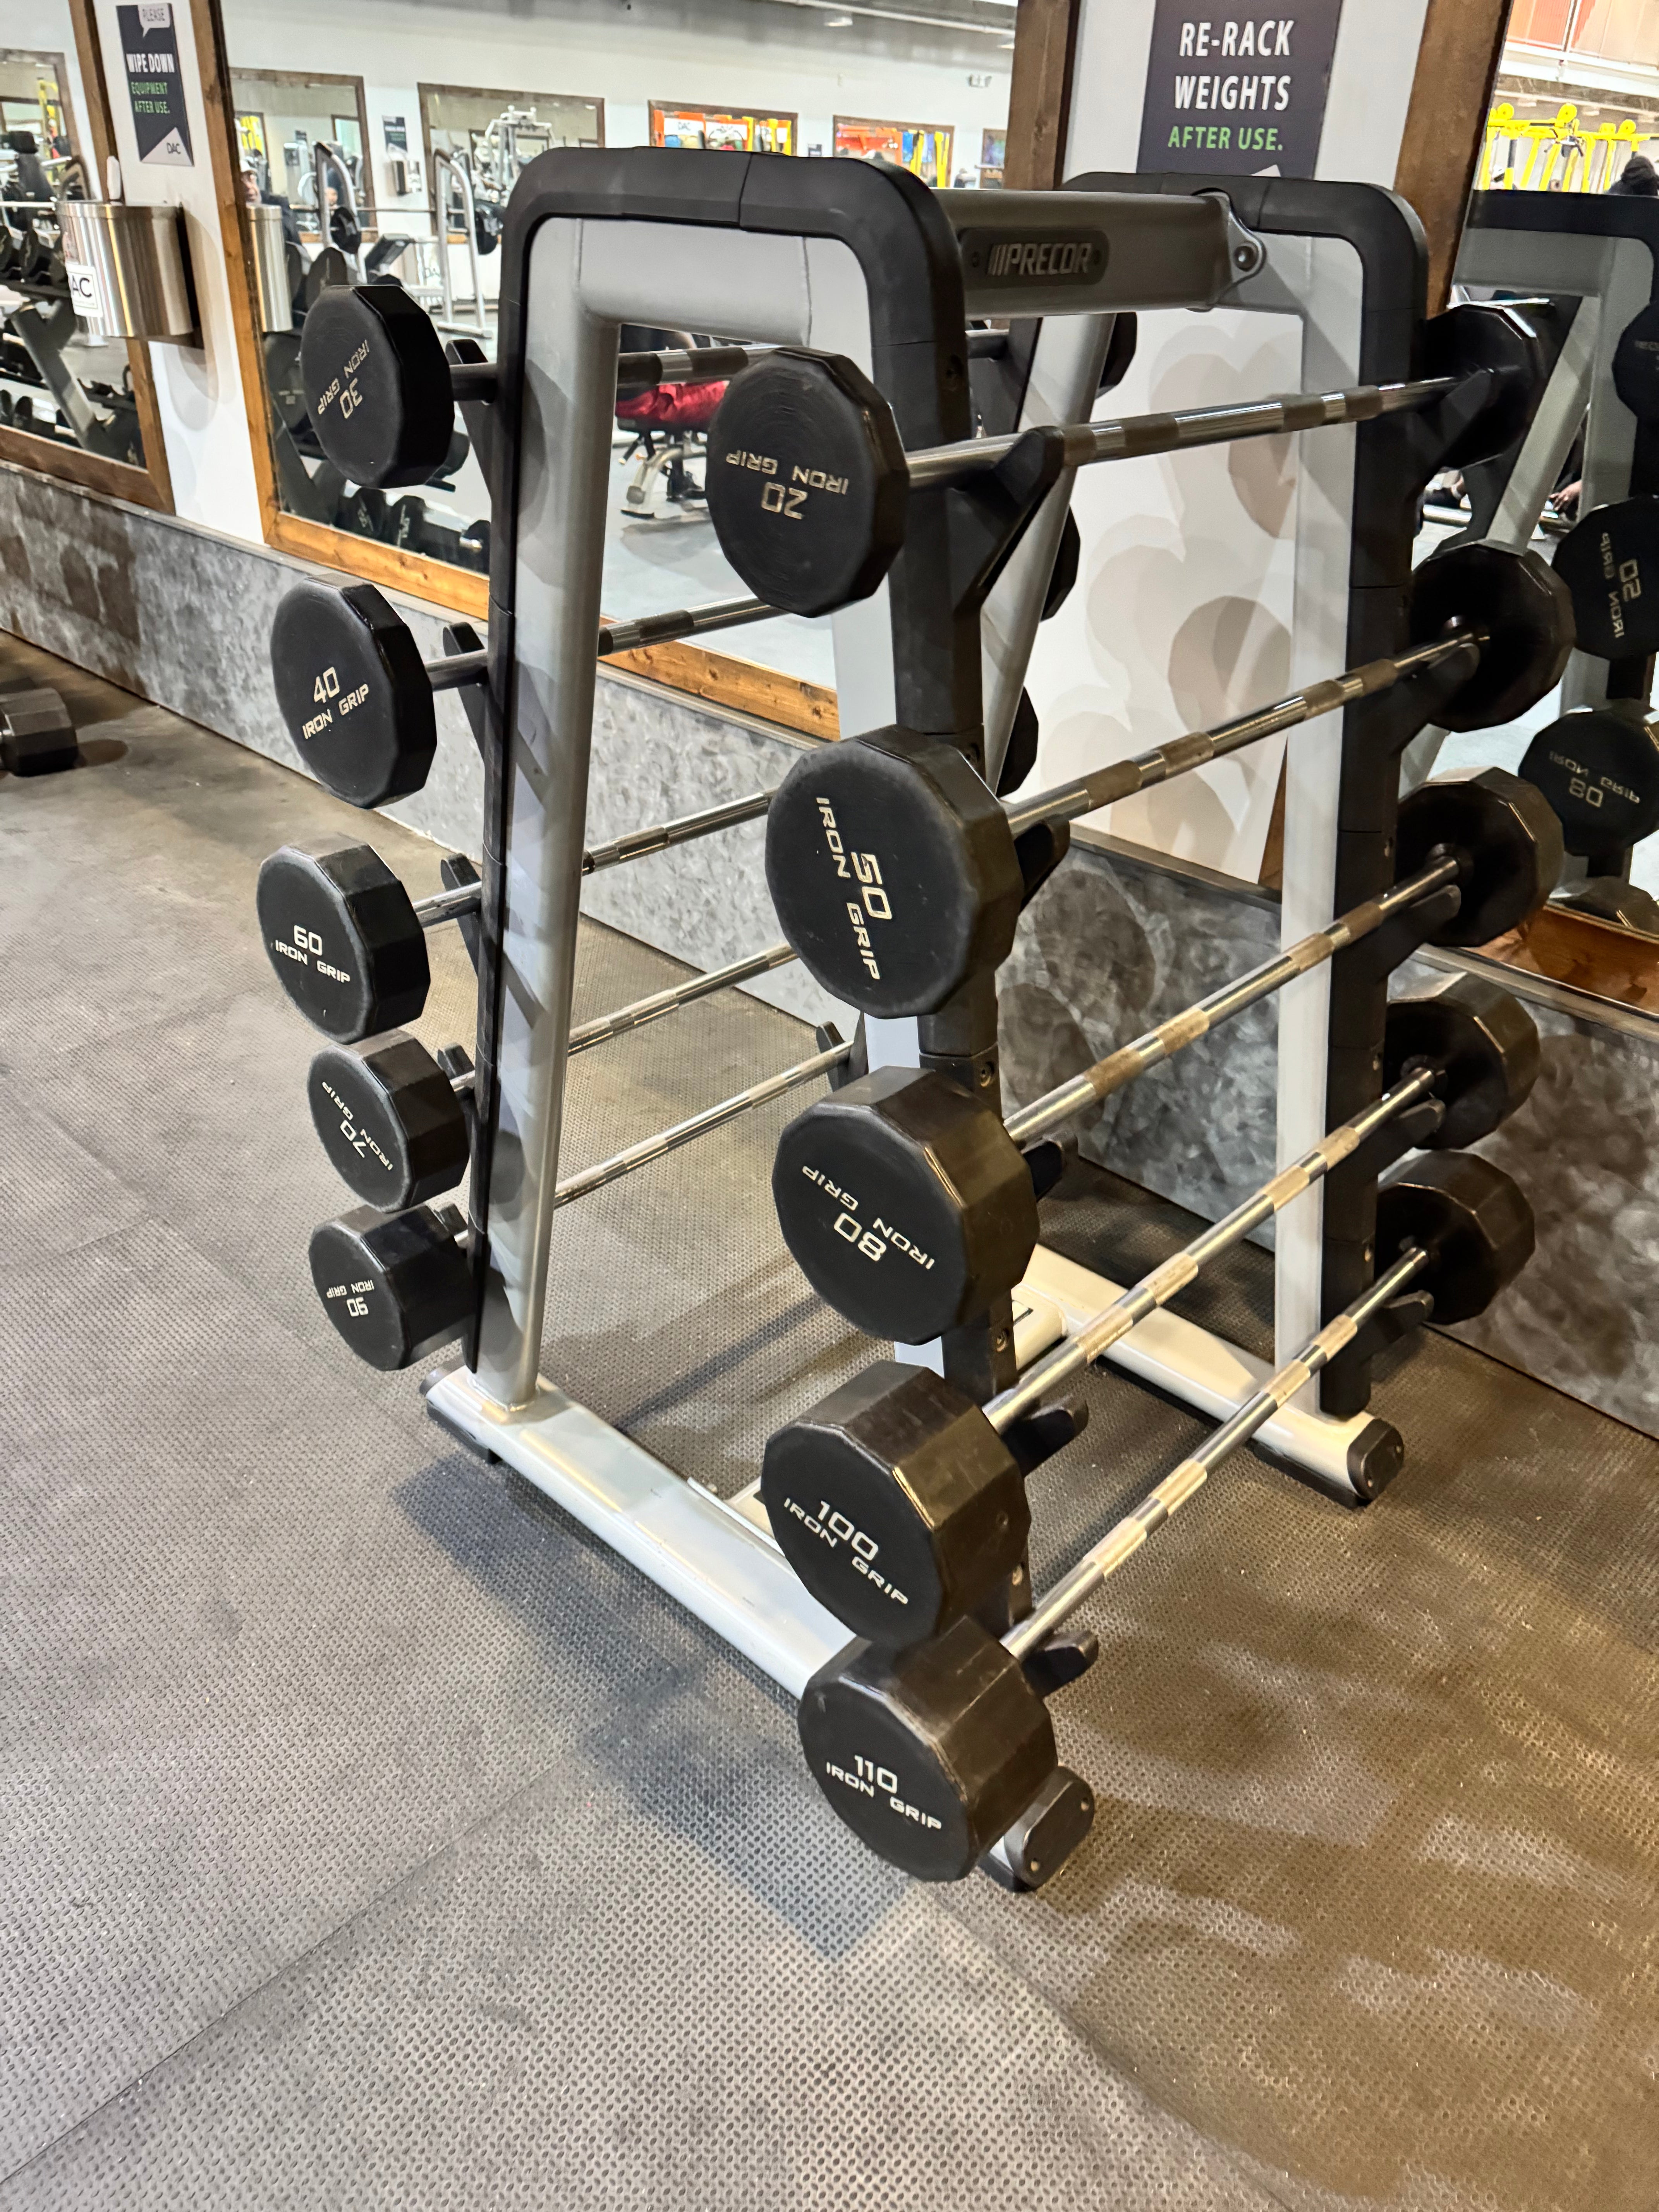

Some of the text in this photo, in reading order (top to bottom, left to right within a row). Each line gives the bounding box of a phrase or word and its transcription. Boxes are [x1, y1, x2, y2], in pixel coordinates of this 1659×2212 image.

[1180, 20, 1294, 57] RE-RACK
[126, 53, 175, 73] WIPE DOWN
[131, 82, 168, 95] EQUIPMENT
[134, 100, 170, 114] AFTER USE.
[1175, 76, 1291, 111] WEIGHTS
[167, 142, 181, 155] DAC
[1168, 126, 1283, 151] AFTER USE.
[1003, 243, 1092, 275] PRECOR
[70, 275, 93, 298] AC
[318, 339, 369, 414] IRON GRIP
[340, 378, 363, 419] 30
[726, 449, 849, 495] IRON GRIP
[761, 481, 808, 520] 20
[313, 666, 340, 704] 40
[302, 684, 369, 739] IRON GRIP
[816, 797, 881, 980] IRON GRIP
[851, 852, 893, 920] 50
[294, 925, 323, 956] 60
[275, 939, 350, 983] IRON GRIP
[322, 1082, 393, 1171] IRON GRIP
[340, 1120, 367, 1158] 70
[802, 1165, 935, 1270] IRON GRIP
[833, 1212, 887, 1262] 80
[326, 1279, 375, 1298] IRON GRIP
[346, 1297, 369, 1317] 90
[817, 1500, 879, 1561] 100
[783, 1497, 908, 1605] IRON GRIP
[854, 1754, 898, 1794] 110
[826, 1762, 942, 1830] IRON GRIP
